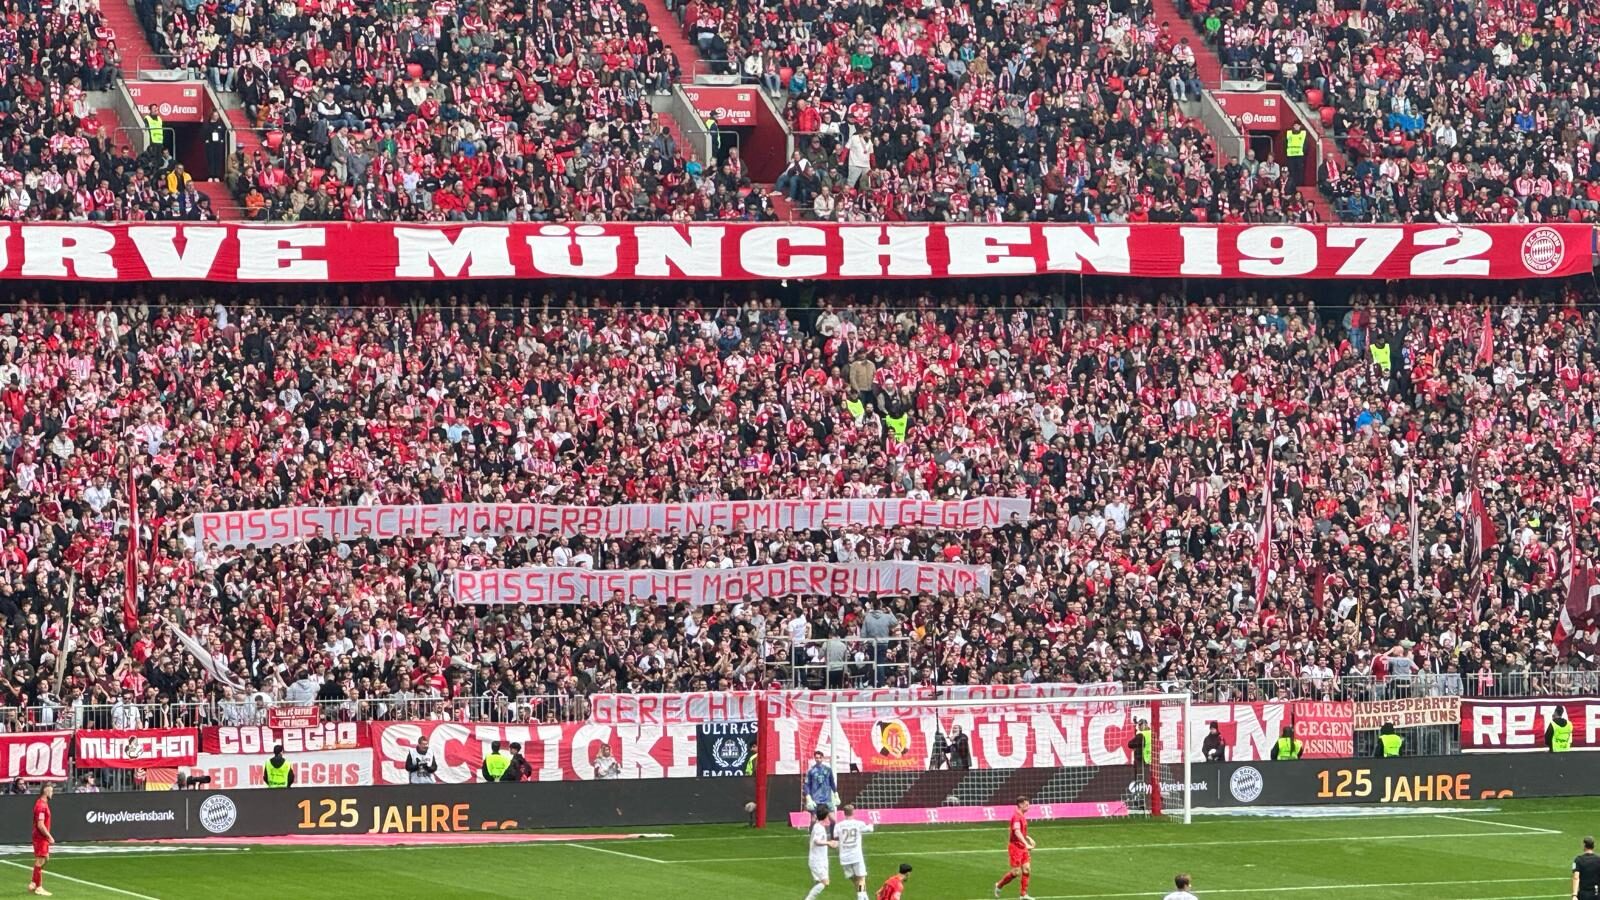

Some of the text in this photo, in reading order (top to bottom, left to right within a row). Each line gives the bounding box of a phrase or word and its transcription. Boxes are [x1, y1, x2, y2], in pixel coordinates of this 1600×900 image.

[172, 105, 197, 114] Arena
[727, 109, 751, 118] Arena
[1254, 114, 1276, 123] Arena
[0, 225, 1493, 280] RVE MÜNCHEN 1972
[203, 507, 440, 542] RASSISTISCHE
[899, 498, 1000, 529] GEGEN
[458, 570, 692, 602] RASSISTISCHE
[1295, 702, 1353, 718] ULTRAS
[1355, 697, 1459, 716] AUSGESPERRTE
[702, 722, 759, 735] ULTRAS
[1295, 720, 1353, 737] GEGEN
[1355, 710, 1457, 729] IMMER BEI UNS
[381, 722, 863, 786] SCHICKEIA
[1302, 739, 1354, 755] ASSISMUS
[8, 737, 67, 777] rot
[1317, 769, 1471, 803] 125 JAHRE
[97, 809, 175, 825] HypoVereinsbank
[297, 798, 471, 834] 125 JAHRE
[842, 828, 858, 844] 29
